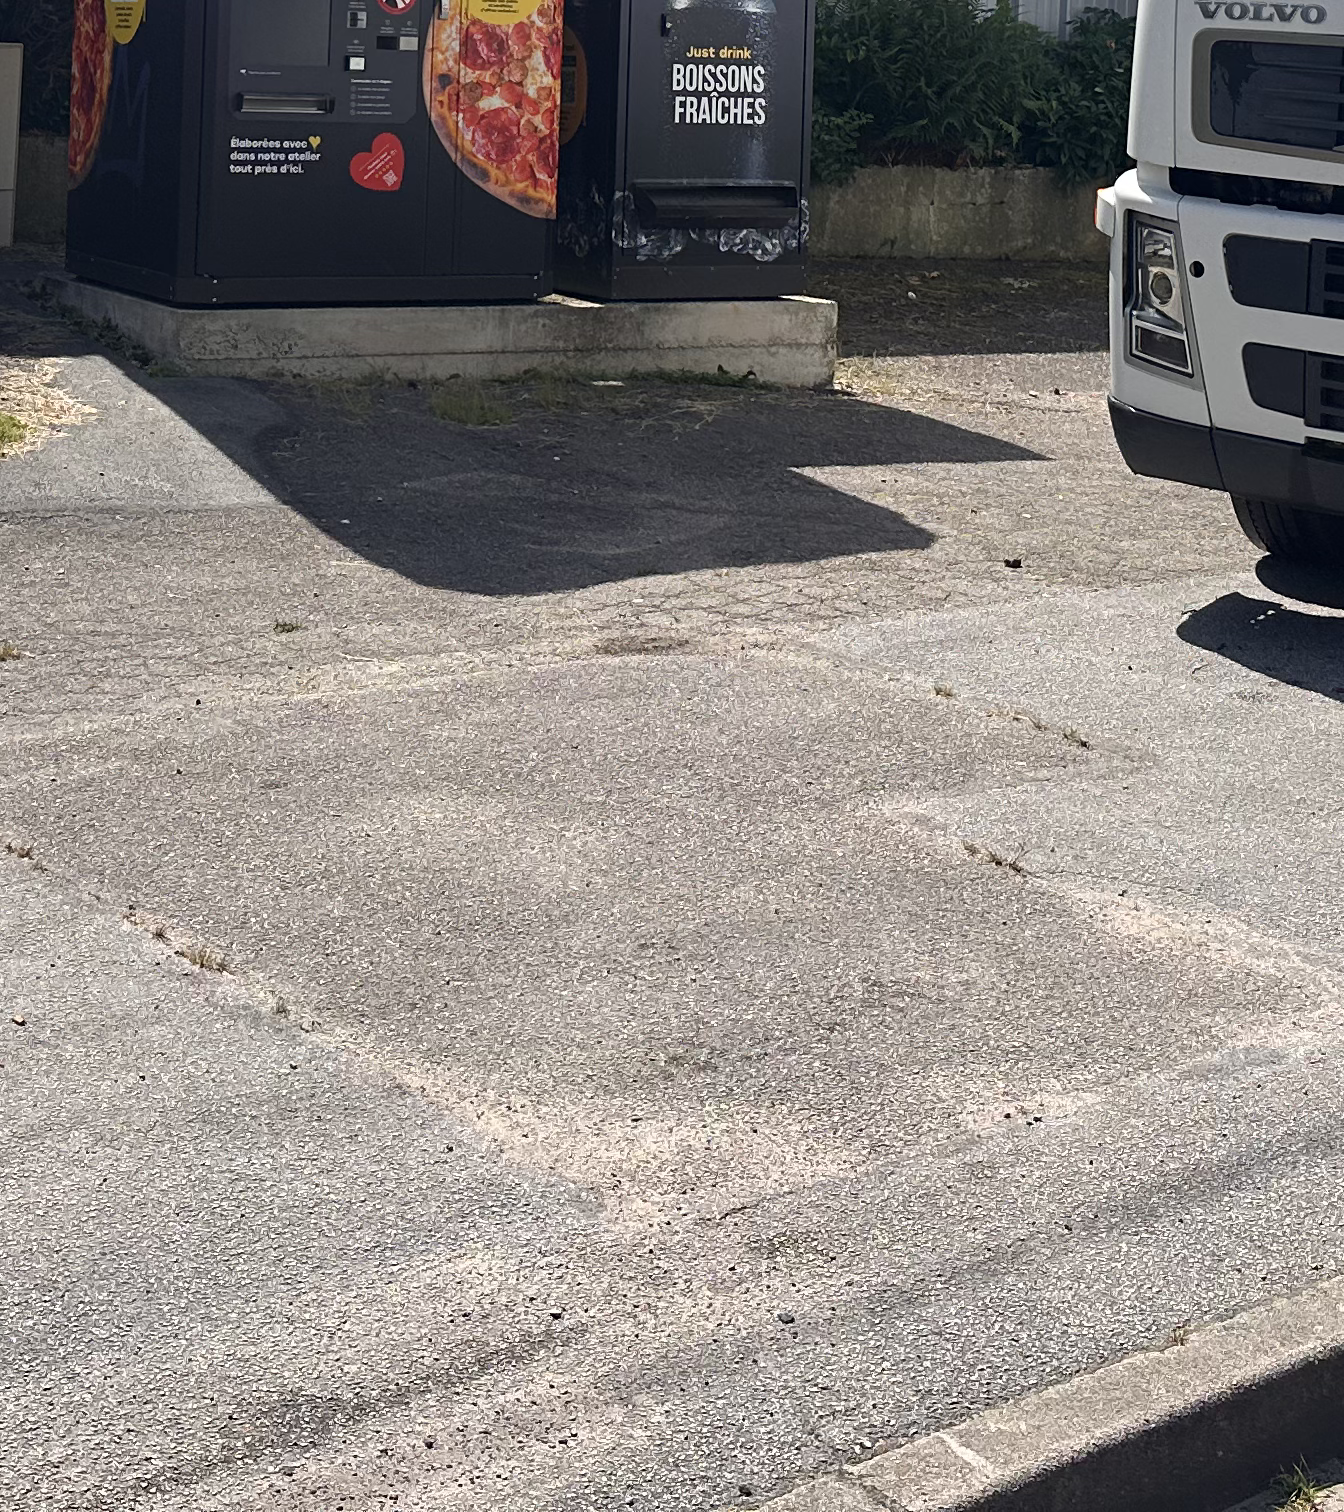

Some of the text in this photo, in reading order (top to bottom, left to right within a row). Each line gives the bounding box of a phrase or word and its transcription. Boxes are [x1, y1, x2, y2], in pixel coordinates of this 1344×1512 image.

[1194, 0, 1328, 24] VOLVO
[685, 45, 752, 59] Just drink
[672, 63, 765, 94] BOISSONS
[674, 91, 766, 125] FRAÎCHES
[282, 139, 308, 149] avec
[229, 150, 321, 161] dans notre atelier
[229, 164, 252, 174] tout
